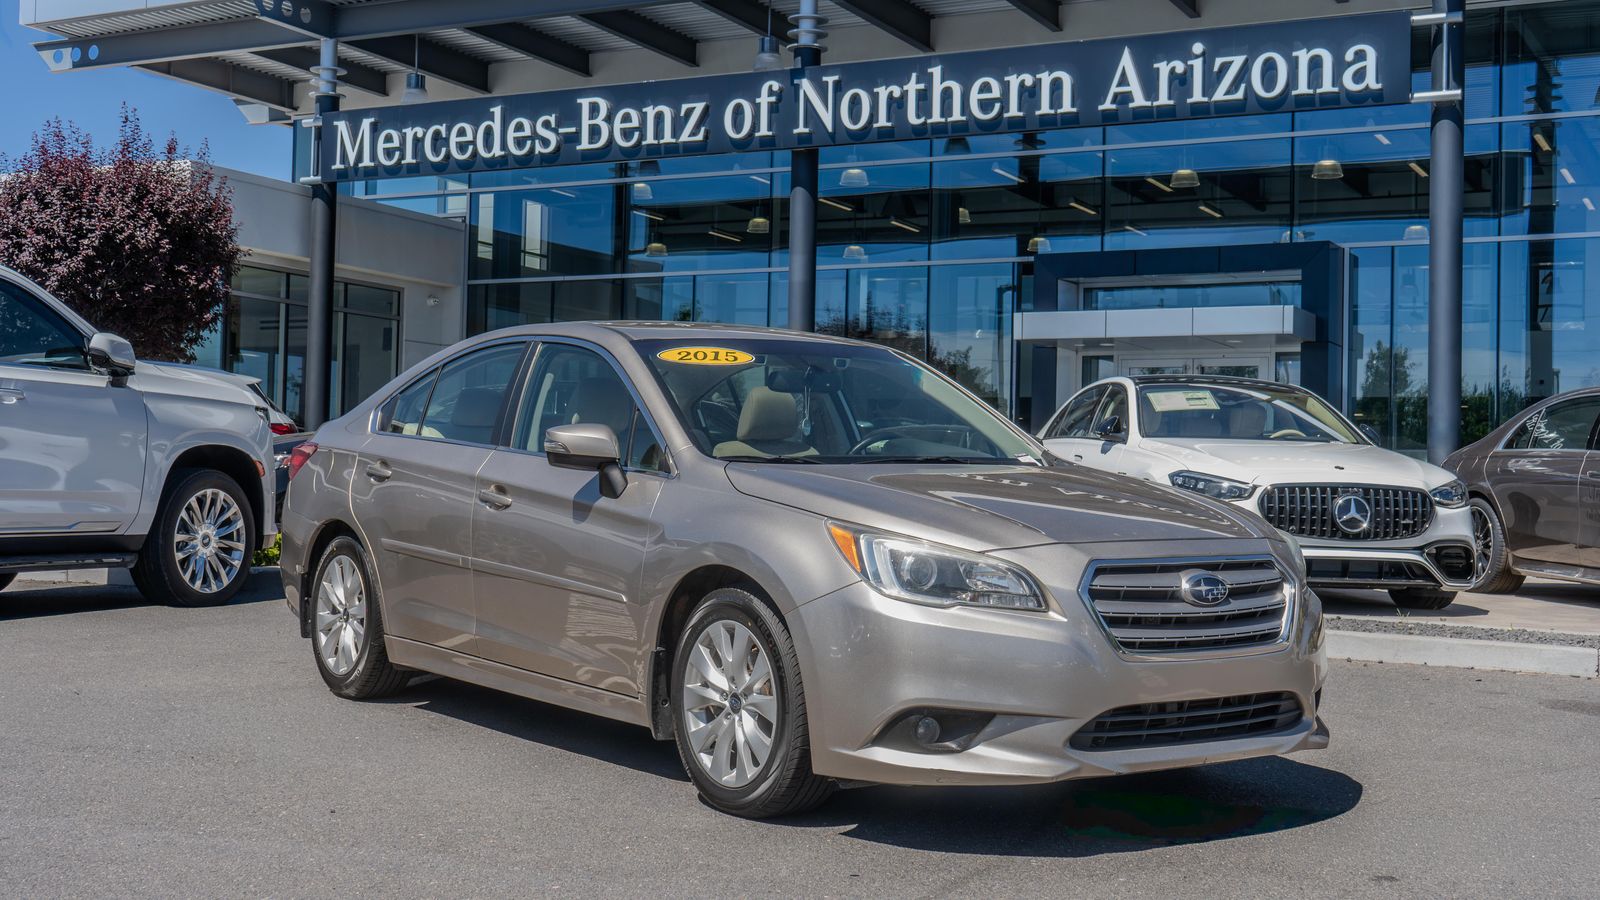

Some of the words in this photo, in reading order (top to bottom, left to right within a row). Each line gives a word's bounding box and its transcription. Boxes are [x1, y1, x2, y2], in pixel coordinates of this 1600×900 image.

[331, 97, 707, 170] Mercedes-Benz
[723, 80, 782, 139] of
[792, 70, 1078, 134] Northern
[1097, 42, 1382, 111] Arizona
[677, 350, 738, 362] 2015
